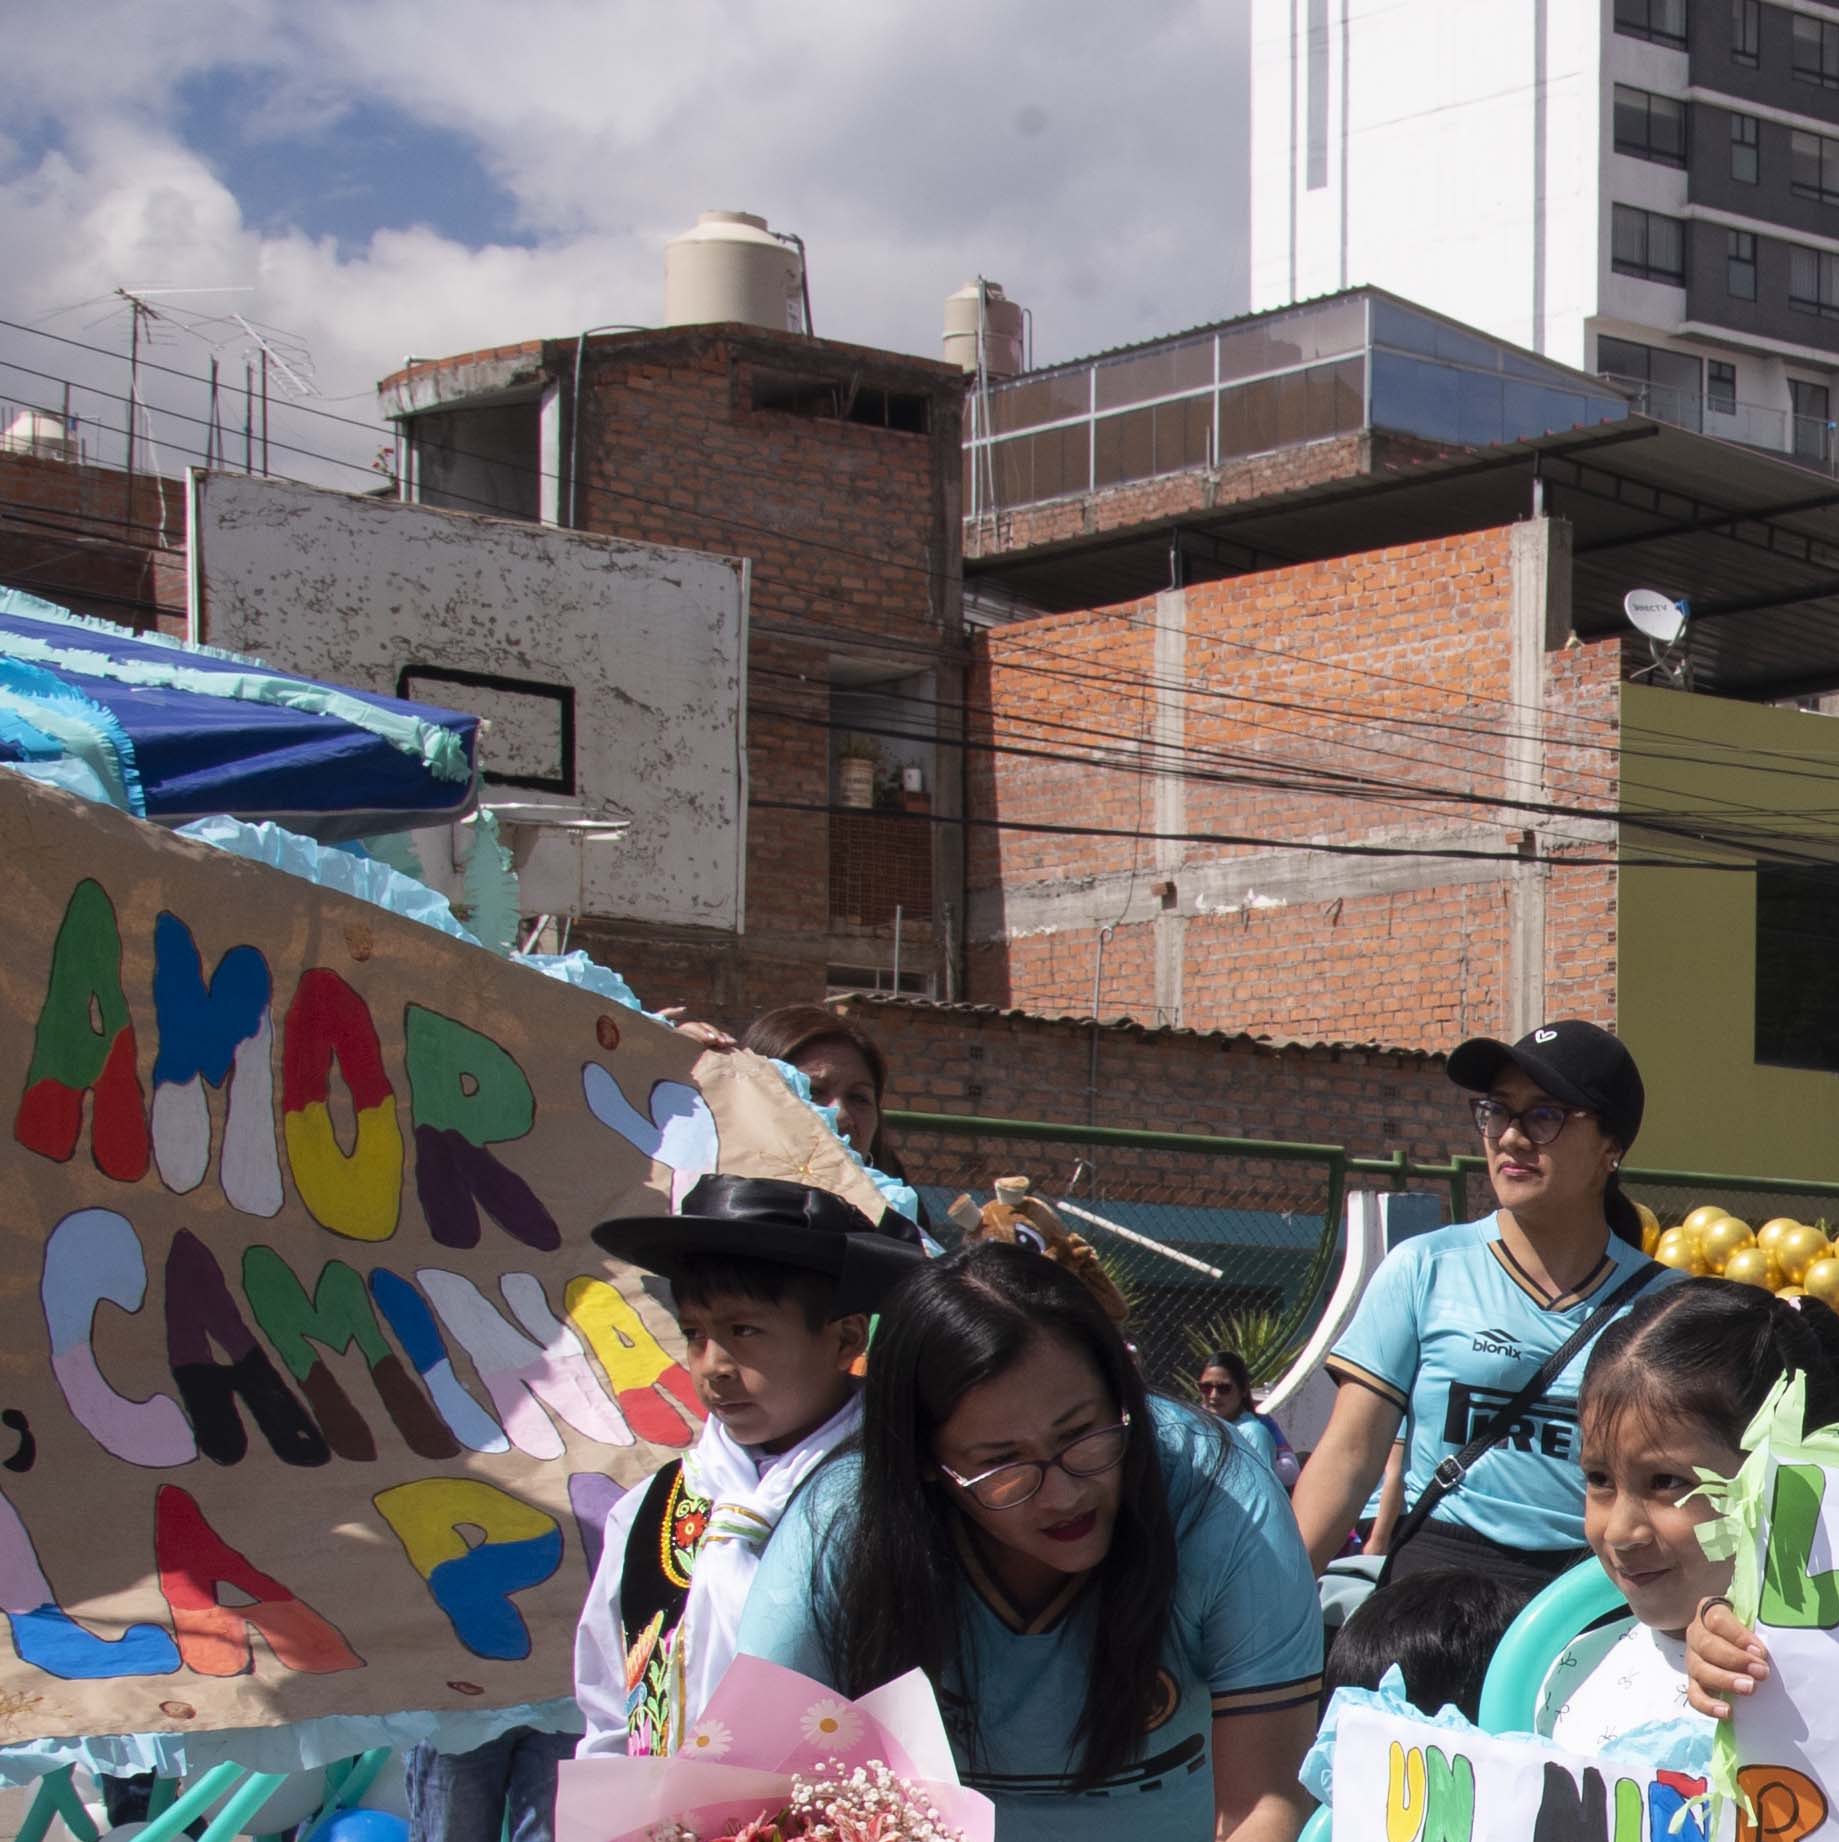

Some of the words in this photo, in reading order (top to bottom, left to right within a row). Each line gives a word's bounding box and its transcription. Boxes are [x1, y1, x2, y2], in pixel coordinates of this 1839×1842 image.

[14, 876, 561, 1253] AMOR
[581, 1061, 719, 1217] Y
[41, 1206, 710, 1469] CAMINA
[0, 1484, 367, 1680] LA
